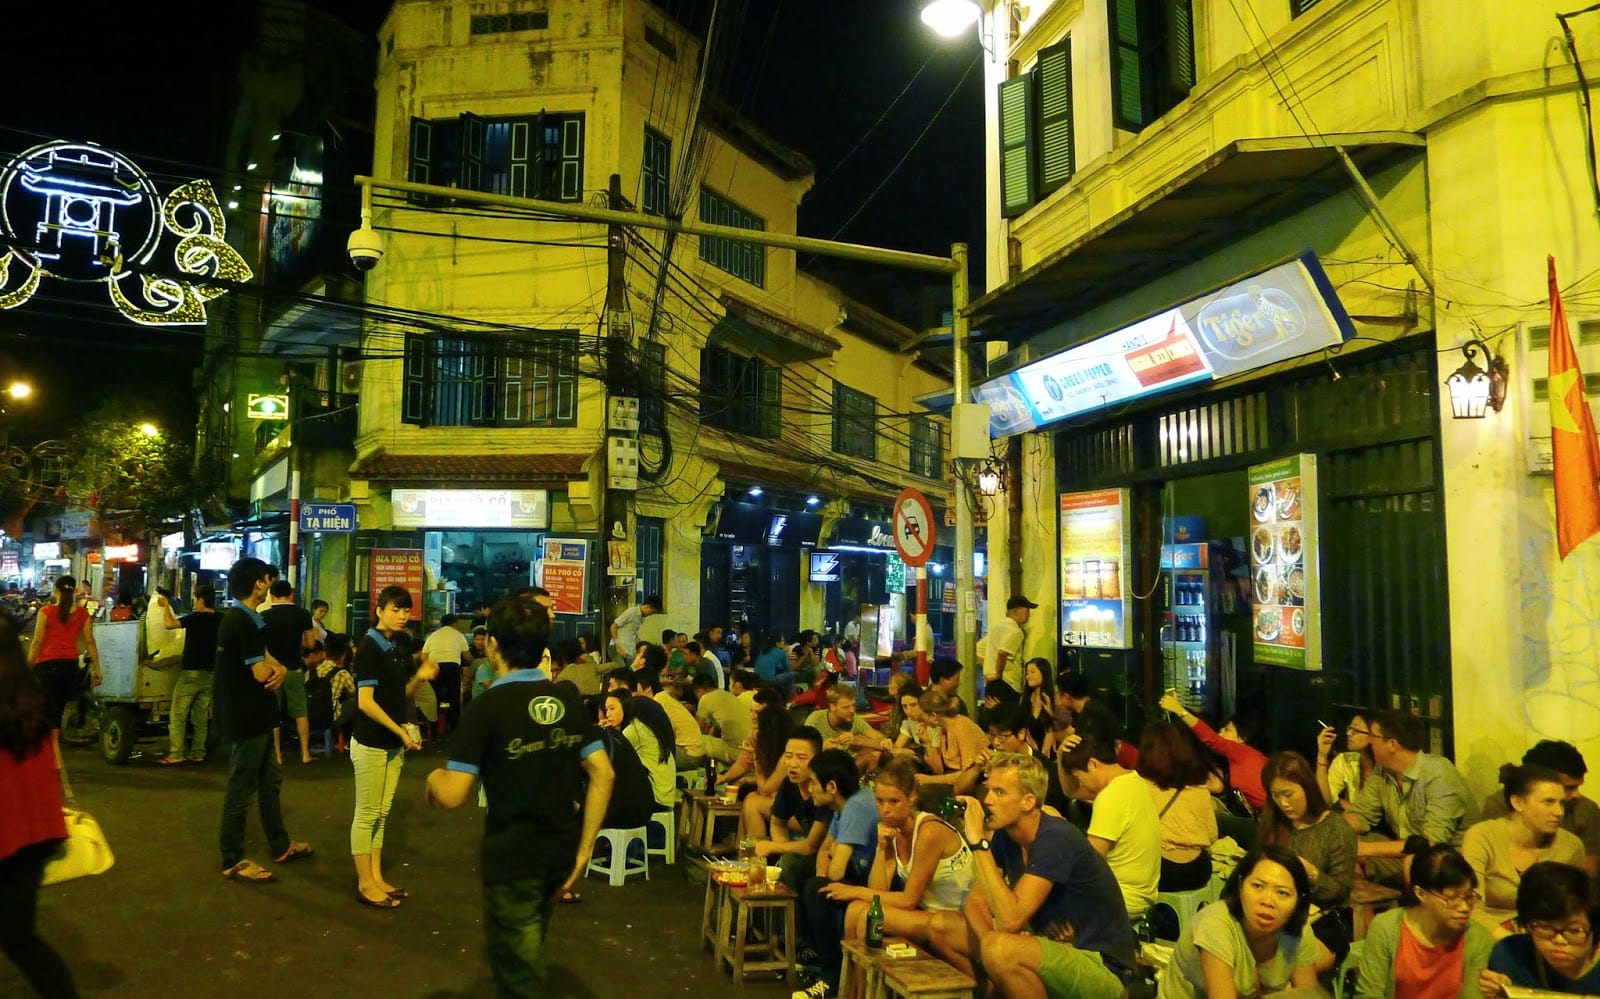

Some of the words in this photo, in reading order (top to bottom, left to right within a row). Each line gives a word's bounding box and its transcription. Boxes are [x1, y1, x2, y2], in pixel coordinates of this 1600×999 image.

[1203, 308, 1265, 347] Tiger
[1059, 370, 1085, 390] GREEN
[1085, 361, 1114, 382] PEPPER
[318, 506, 337, 515] PHỐ
[306, 517, 320, 530] TẠ
[322, 515, 350, 531] HIỆN
[375, 554, 390, 563] BIA
